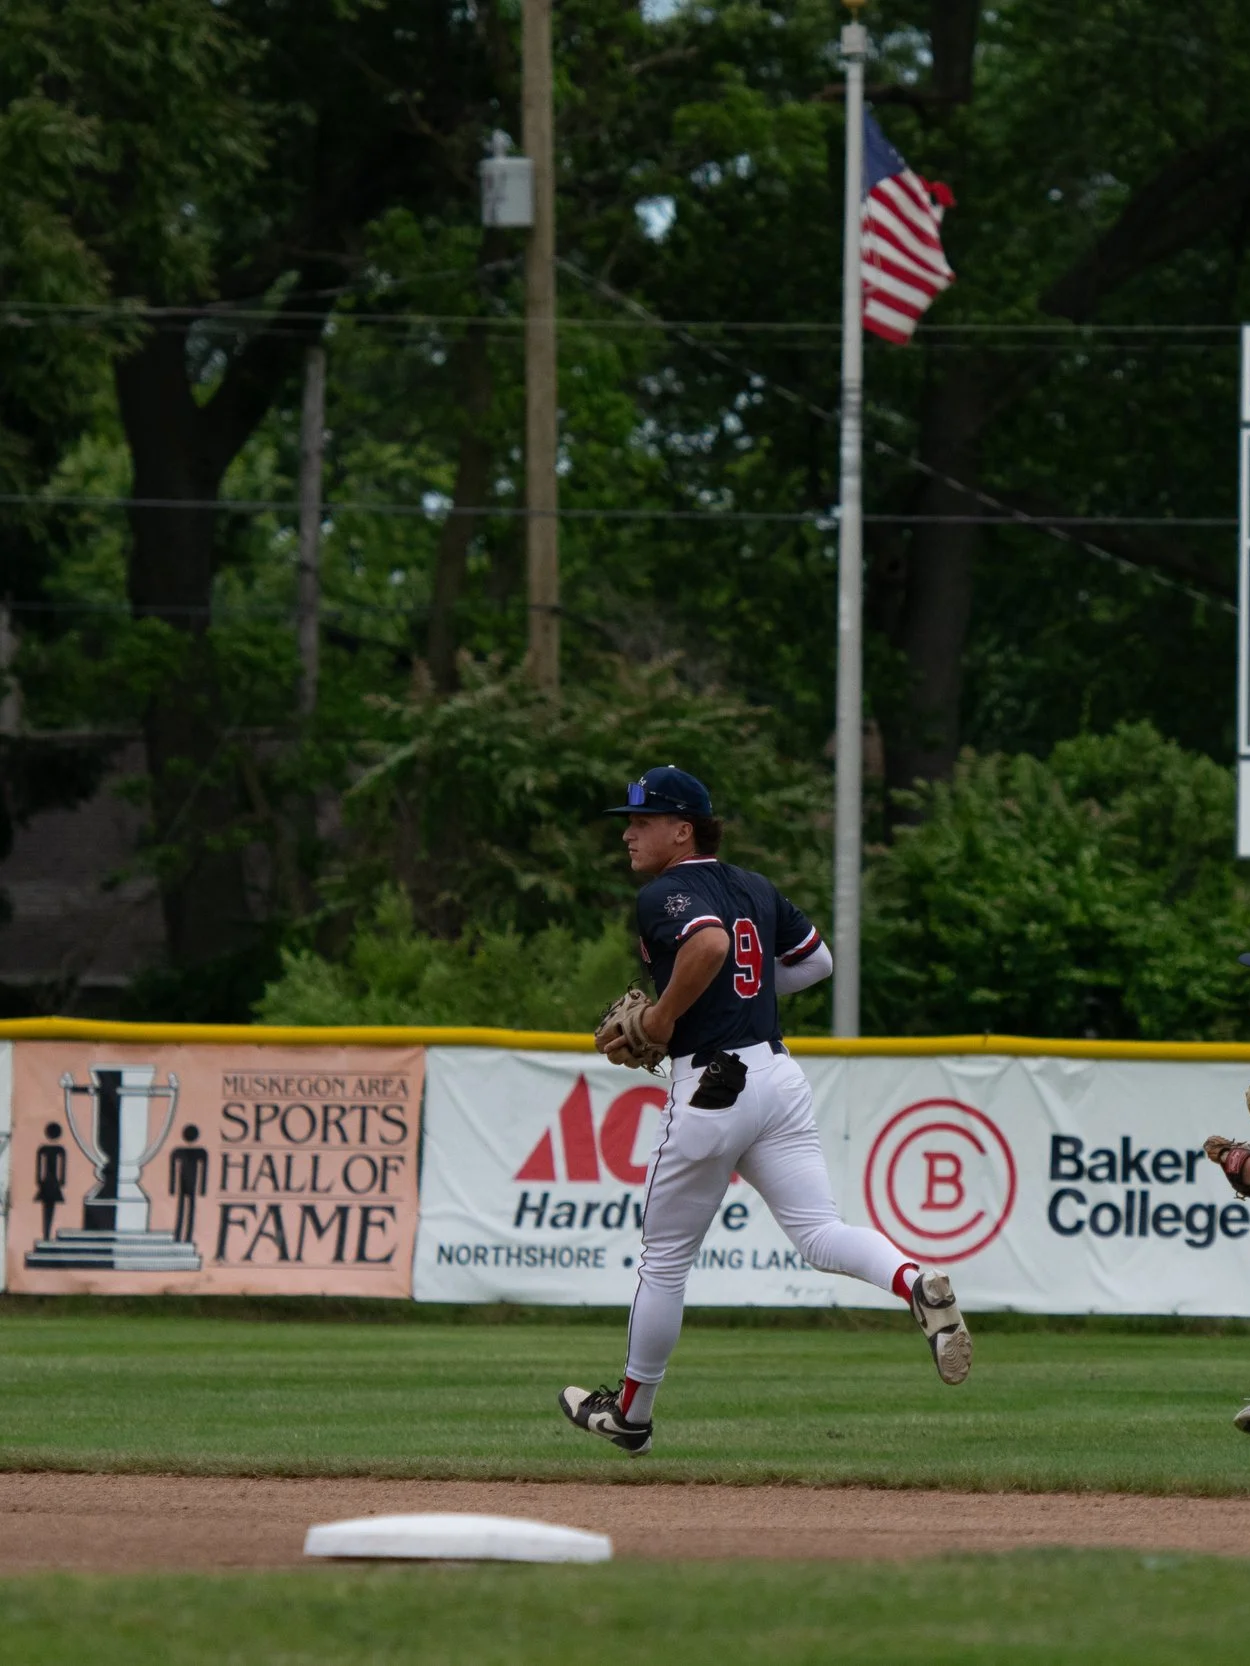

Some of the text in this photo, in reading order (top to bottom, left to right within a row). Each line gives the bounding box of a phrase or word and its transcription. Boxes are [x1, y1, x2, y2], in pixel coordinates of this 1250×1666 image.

[732, 918, 763, 999] 9
[222, 1075, 409, 1097] MUSKEGON AREA
[220, 1102, 408, 1146] SPORTS
[219, 1152, 405, 1194] HALL OF
[1049, 1134, 1206, 1185] Baker
[214, 1204, 397, 1264] FAME
[1047, 1188, 1250, 1249] College
[436, 1245, 606, 1269] NORTHSHORE
